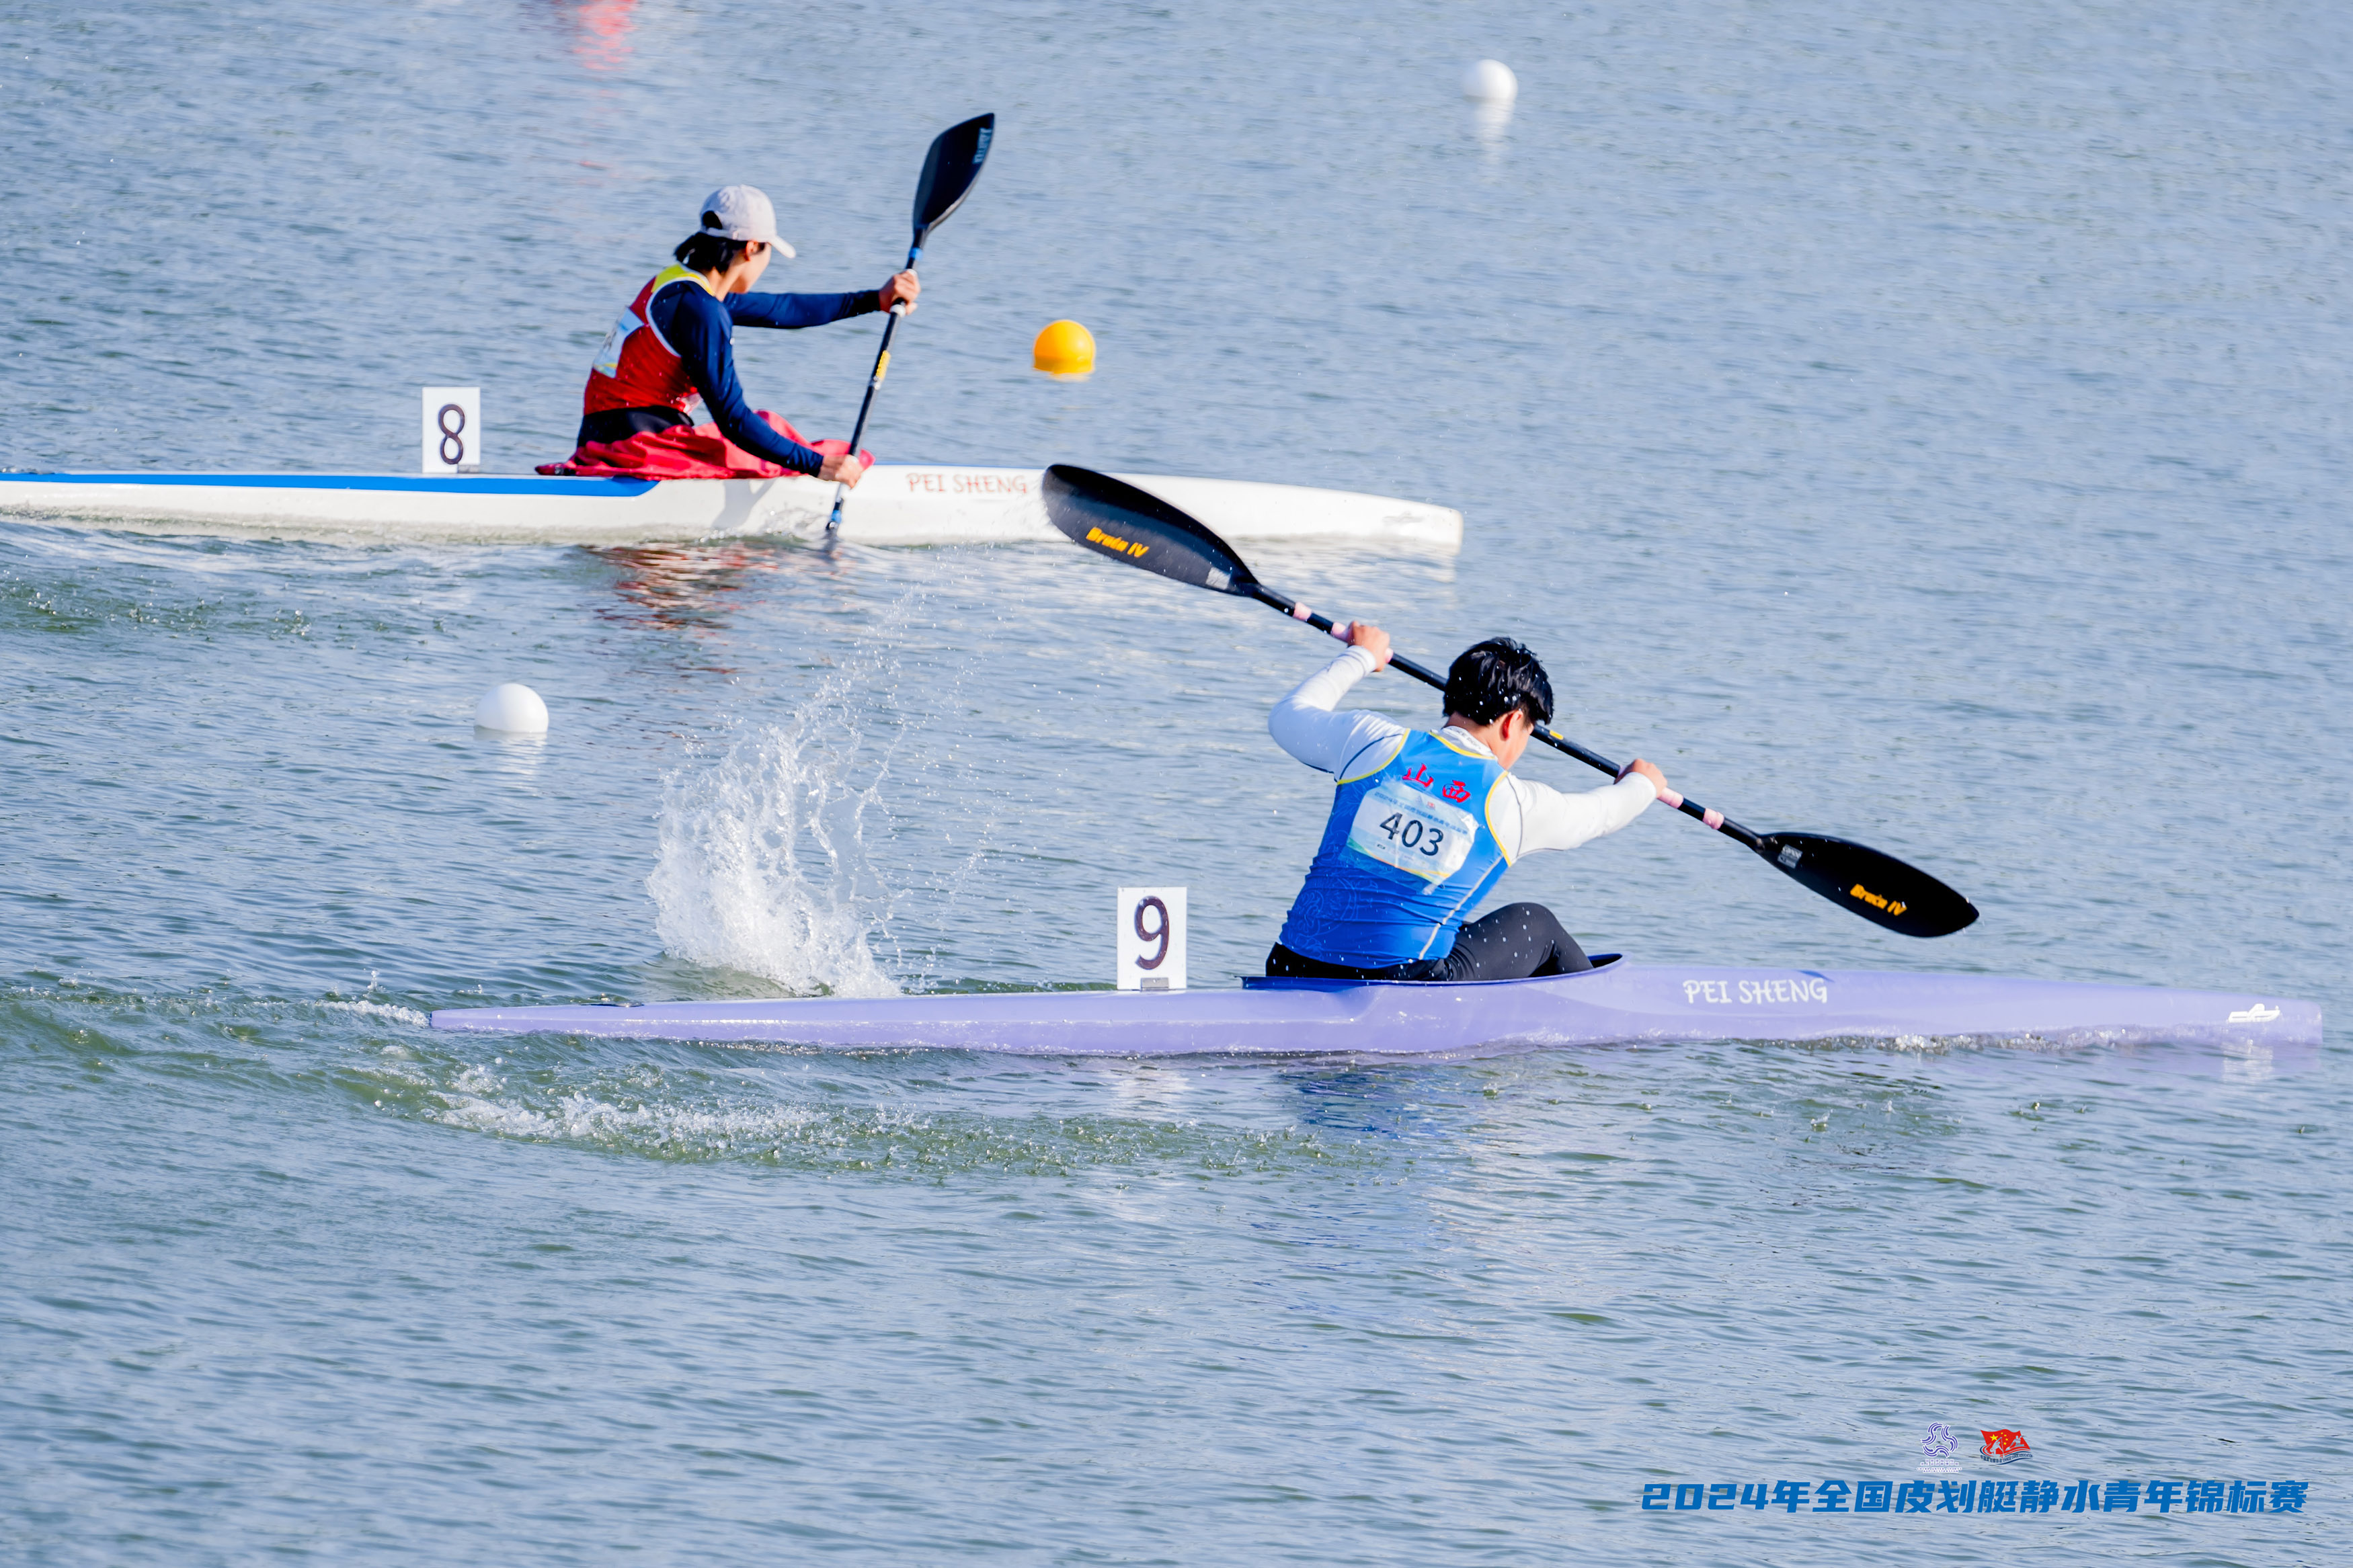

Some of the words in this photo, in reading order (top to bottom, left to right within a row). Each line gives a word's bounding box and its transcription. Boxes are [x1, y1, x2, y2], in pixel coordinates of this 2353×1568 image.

[438, 403, 465, 465] 8
[906, 472, 946, 493] PEI
[953, 473, 1027, 494] SHENG
[1127, 542, 1150, 558] IV
[1402, 763, 1472, 803] 山西
[1380, 812, 1444, 856] 403
[1886, 901, 1907, 916] IV
[1134, 895, 1170, 971] 9
[1683, 979, 1732, 1004] PEI
[1738, 978, 1828, 1005] SHENG
